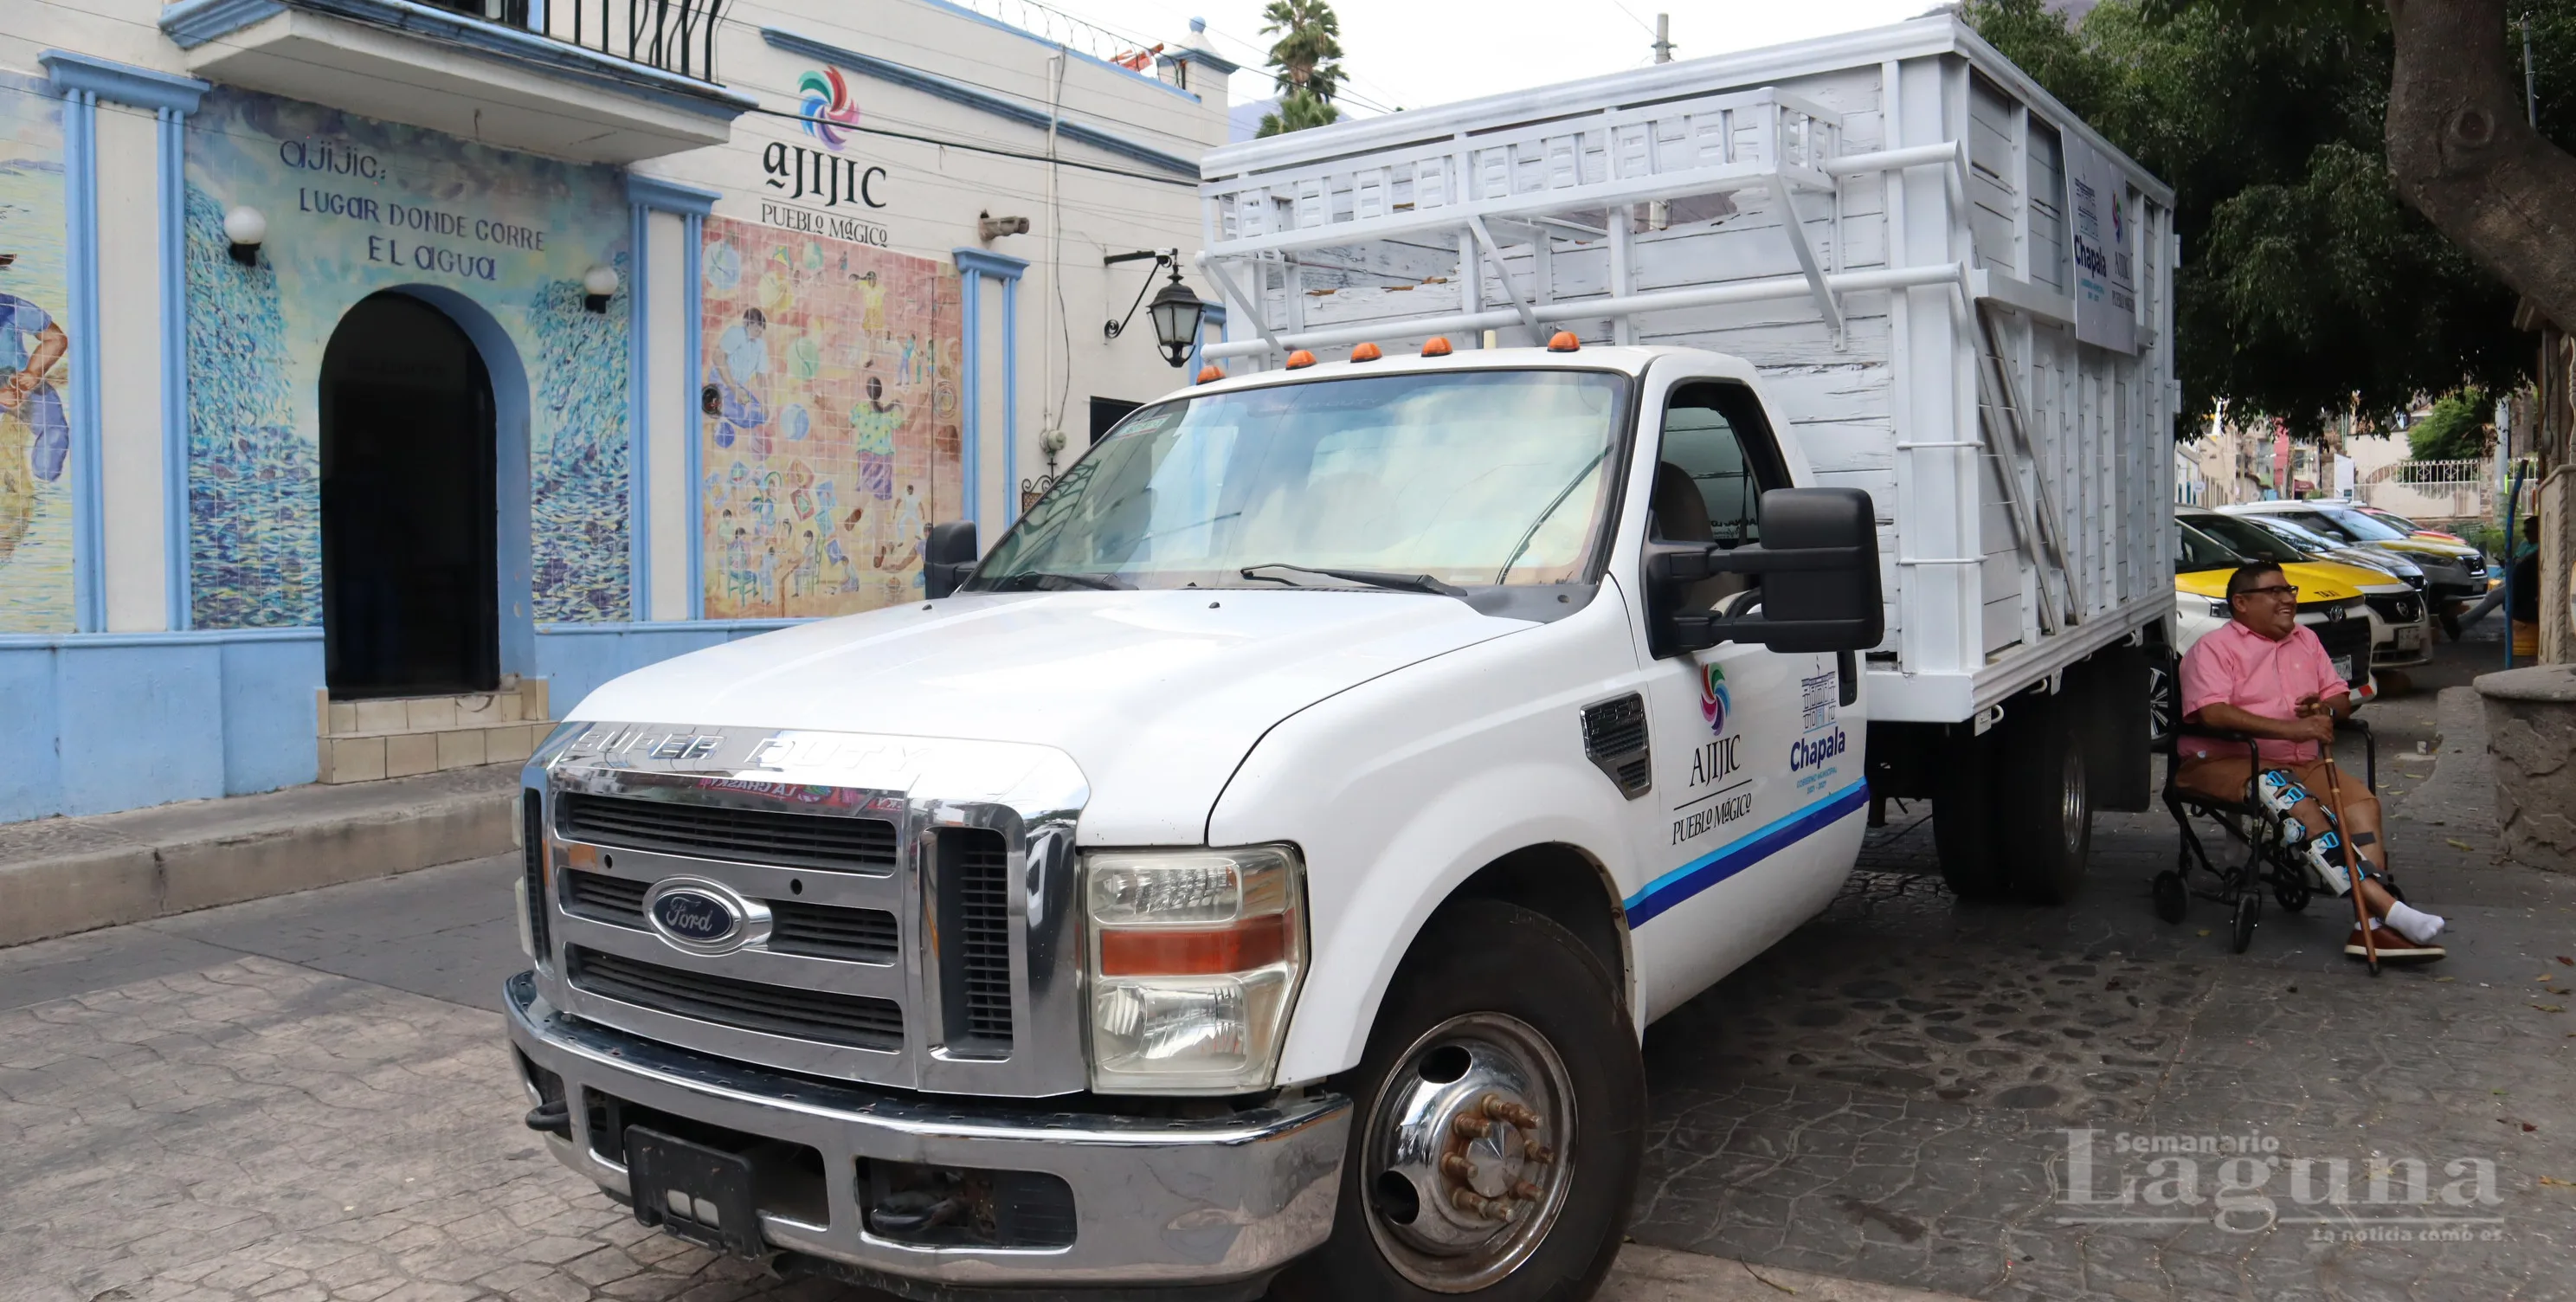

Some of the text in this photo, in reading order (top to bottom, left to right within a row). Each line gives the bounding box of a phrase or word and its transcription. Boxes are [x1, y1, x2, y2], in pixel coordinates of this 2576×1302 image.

[389, 203, 467, 238] DONDE
[475, 219, 548, 252] CORRE
[368, 235, 406, 267] EL
[2074, 235, 2107, 279] Chapala
[571, 729, 931, 771] SUPER DUTY
[1689, 734, 1741, 787] AJIJIC
[1790, 726, 1845, 771] Chapala
[666, 896, 713, 932] Ford
